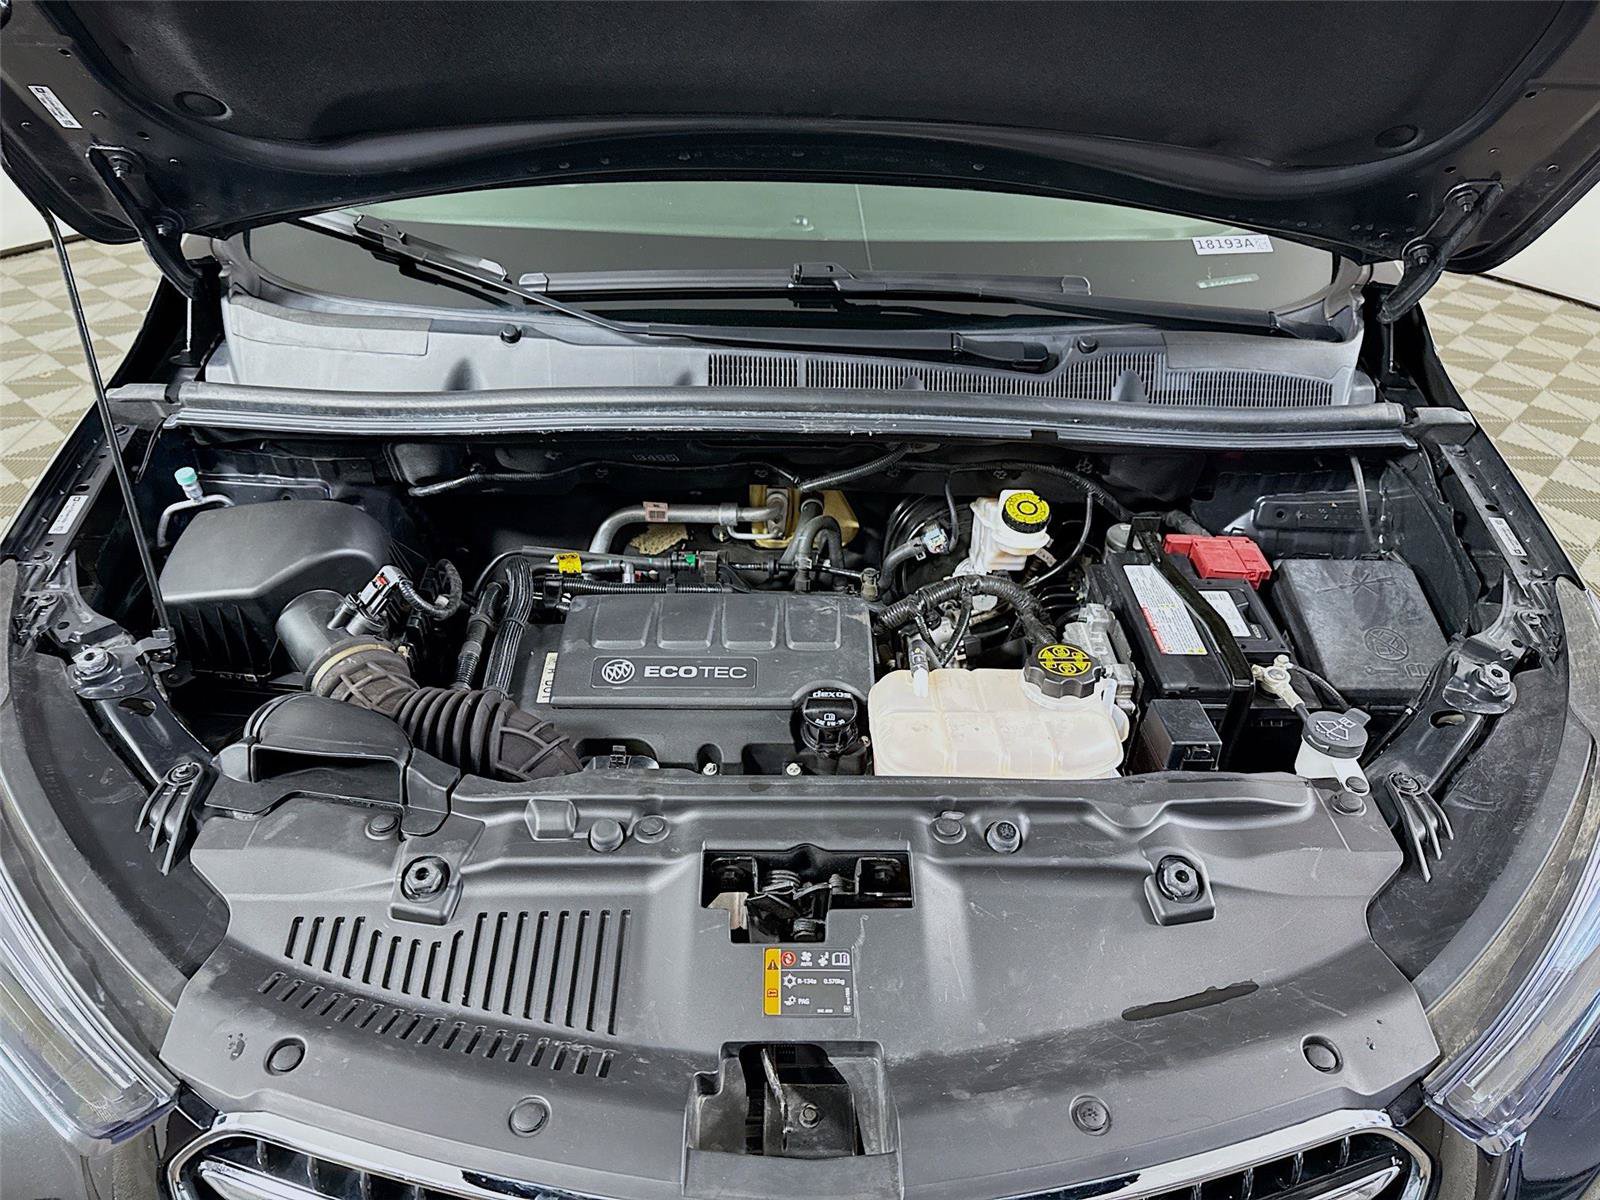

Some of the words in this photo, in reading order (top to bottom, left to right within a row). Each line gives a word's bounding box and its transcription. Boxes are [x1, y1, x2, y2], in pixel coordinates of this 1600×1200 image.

[1195, 238, 1255, 250] 18193A
[644, 665, 748, 679] ECOTEC
[812, 690, 852, 698] dexos
